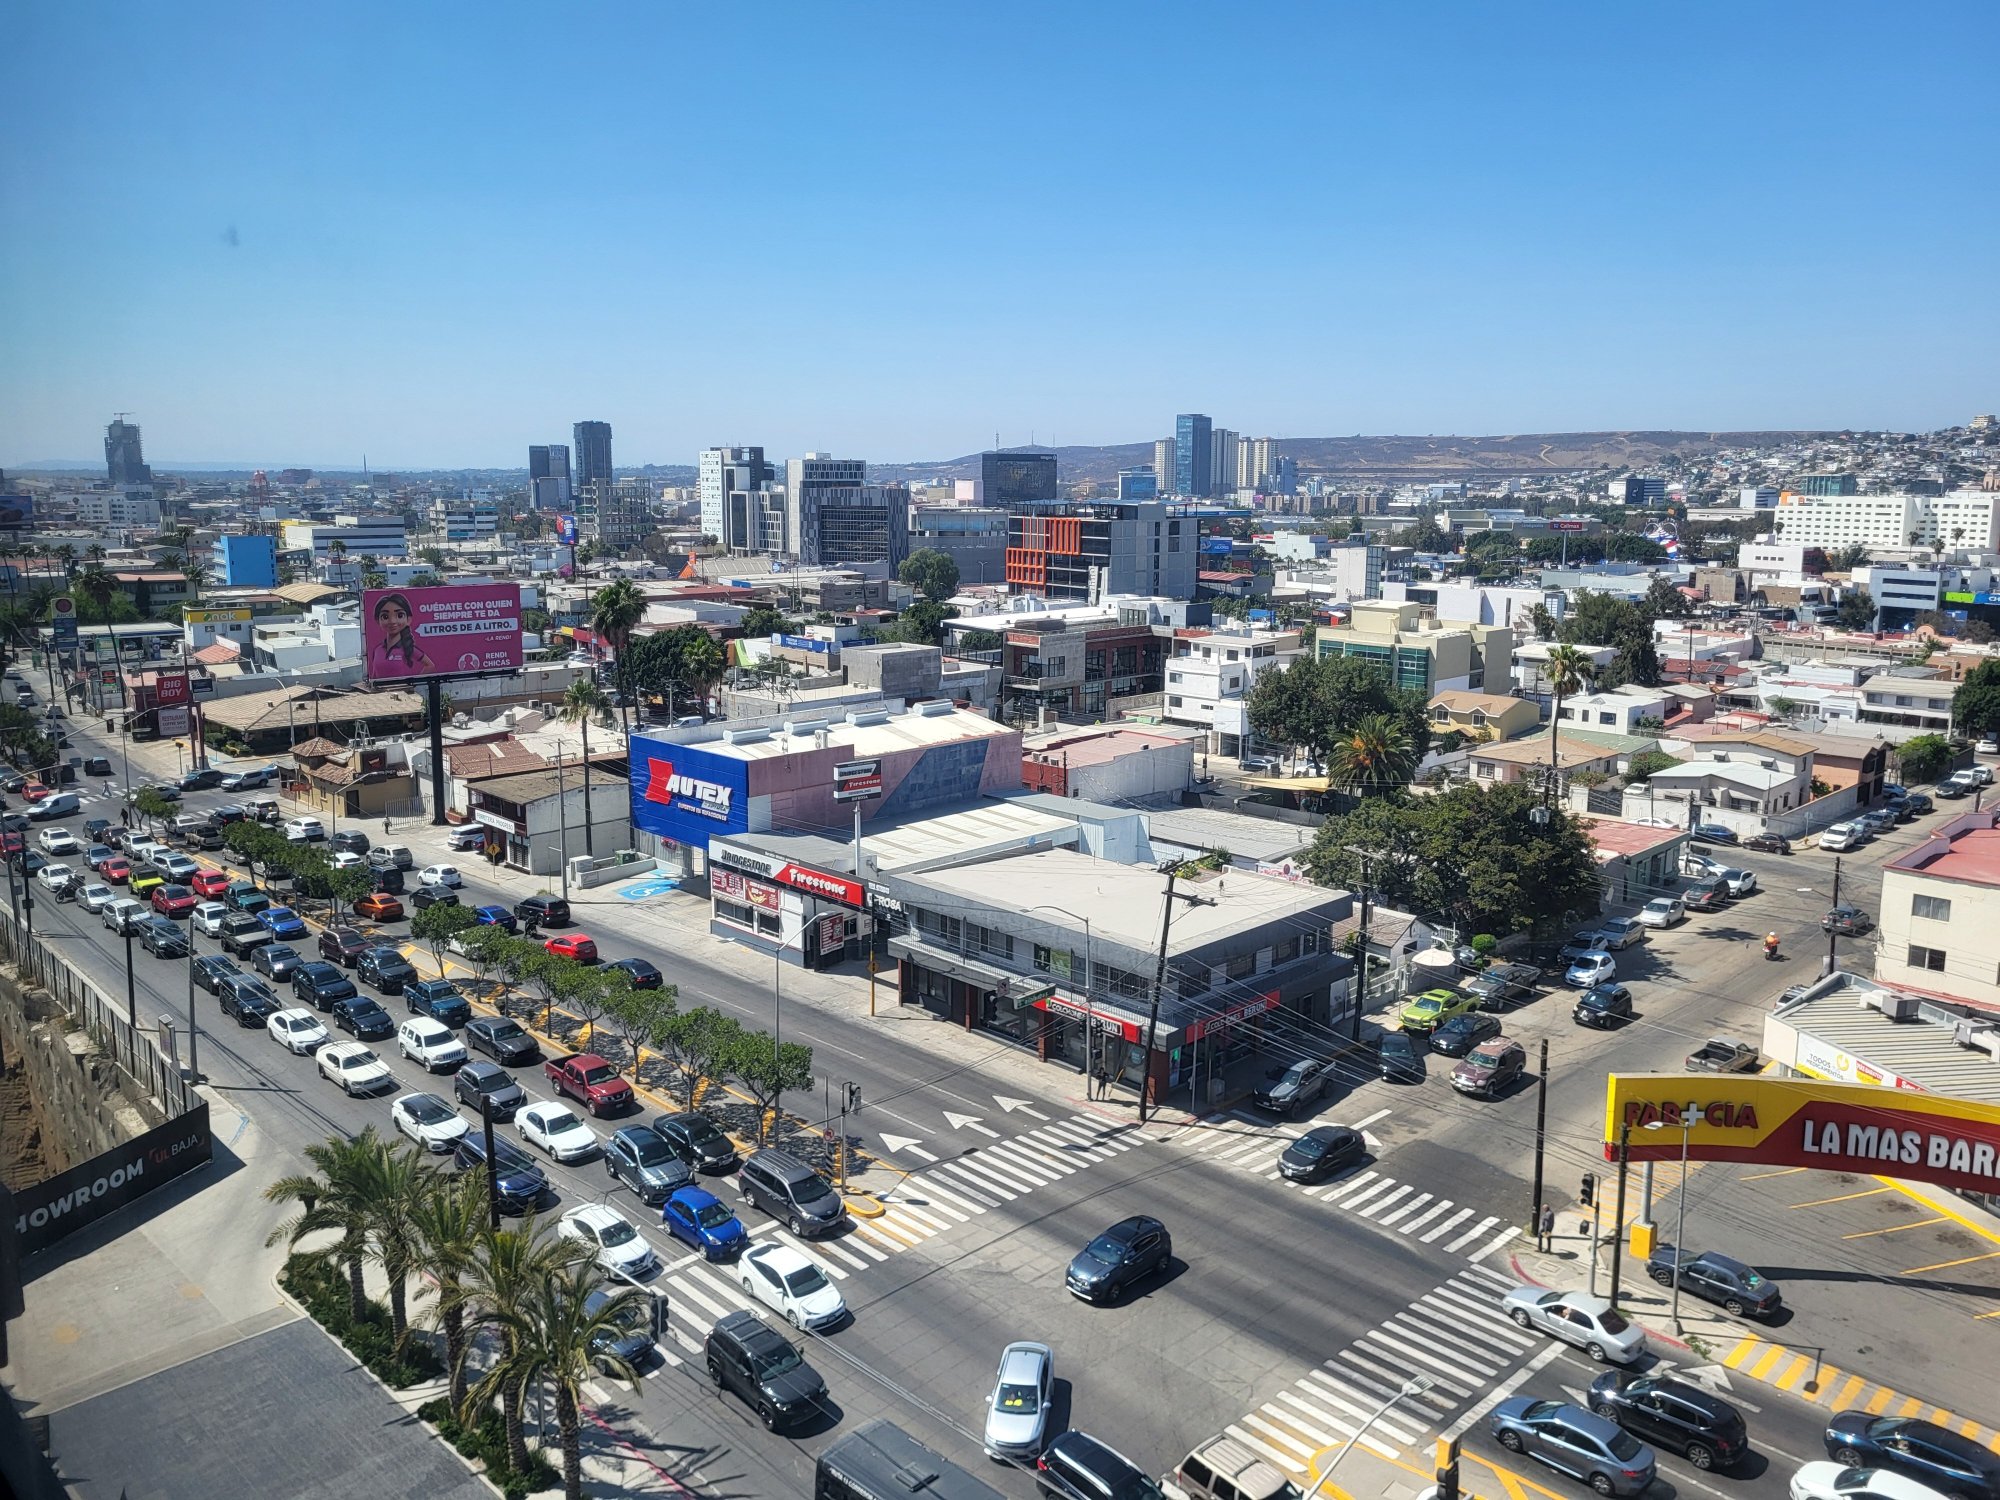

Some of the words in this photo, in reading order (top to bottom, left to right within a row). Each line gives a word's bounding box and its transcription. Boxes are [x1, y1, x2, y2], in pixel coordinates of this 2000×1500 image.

[420, 602, 462, 612] QUÉDATE
[464, 601, 484, 610] CON
[485, 600, 513, 608] QUIEN
[434, 610, 473, 620] SIEMPRE
[474, 610, 486, 618] TE
[424, 624, 458, 634] LITROS
[460, 624, 474, 632] DE
[474, 623, 482, 631] A
[483, 621, 512, 630] LITRO.
[485, 651, 508, 659] RENDI
[483, 659, 511, 668] CHICAS
[163, 680, 181, 689] BIG
[161, 688, 182, 697] BOY
[849, 778, 880, 788] Firestone
[665, 774, 732, 806] AUTEX
[721, 849, 772, 874] BRIDGESTONE
[789, 868, 846, 895] Firestone
[1810, 1053, 1831, 1068] TODOS
[1806, 1058, 1844, 1080] MEDICAMENTOS
[171, 1134, 199, 1156] BAJA
[1803, 1119, 1841, 1155] LA
[1847, 1123, 1921, 1165] MAS
